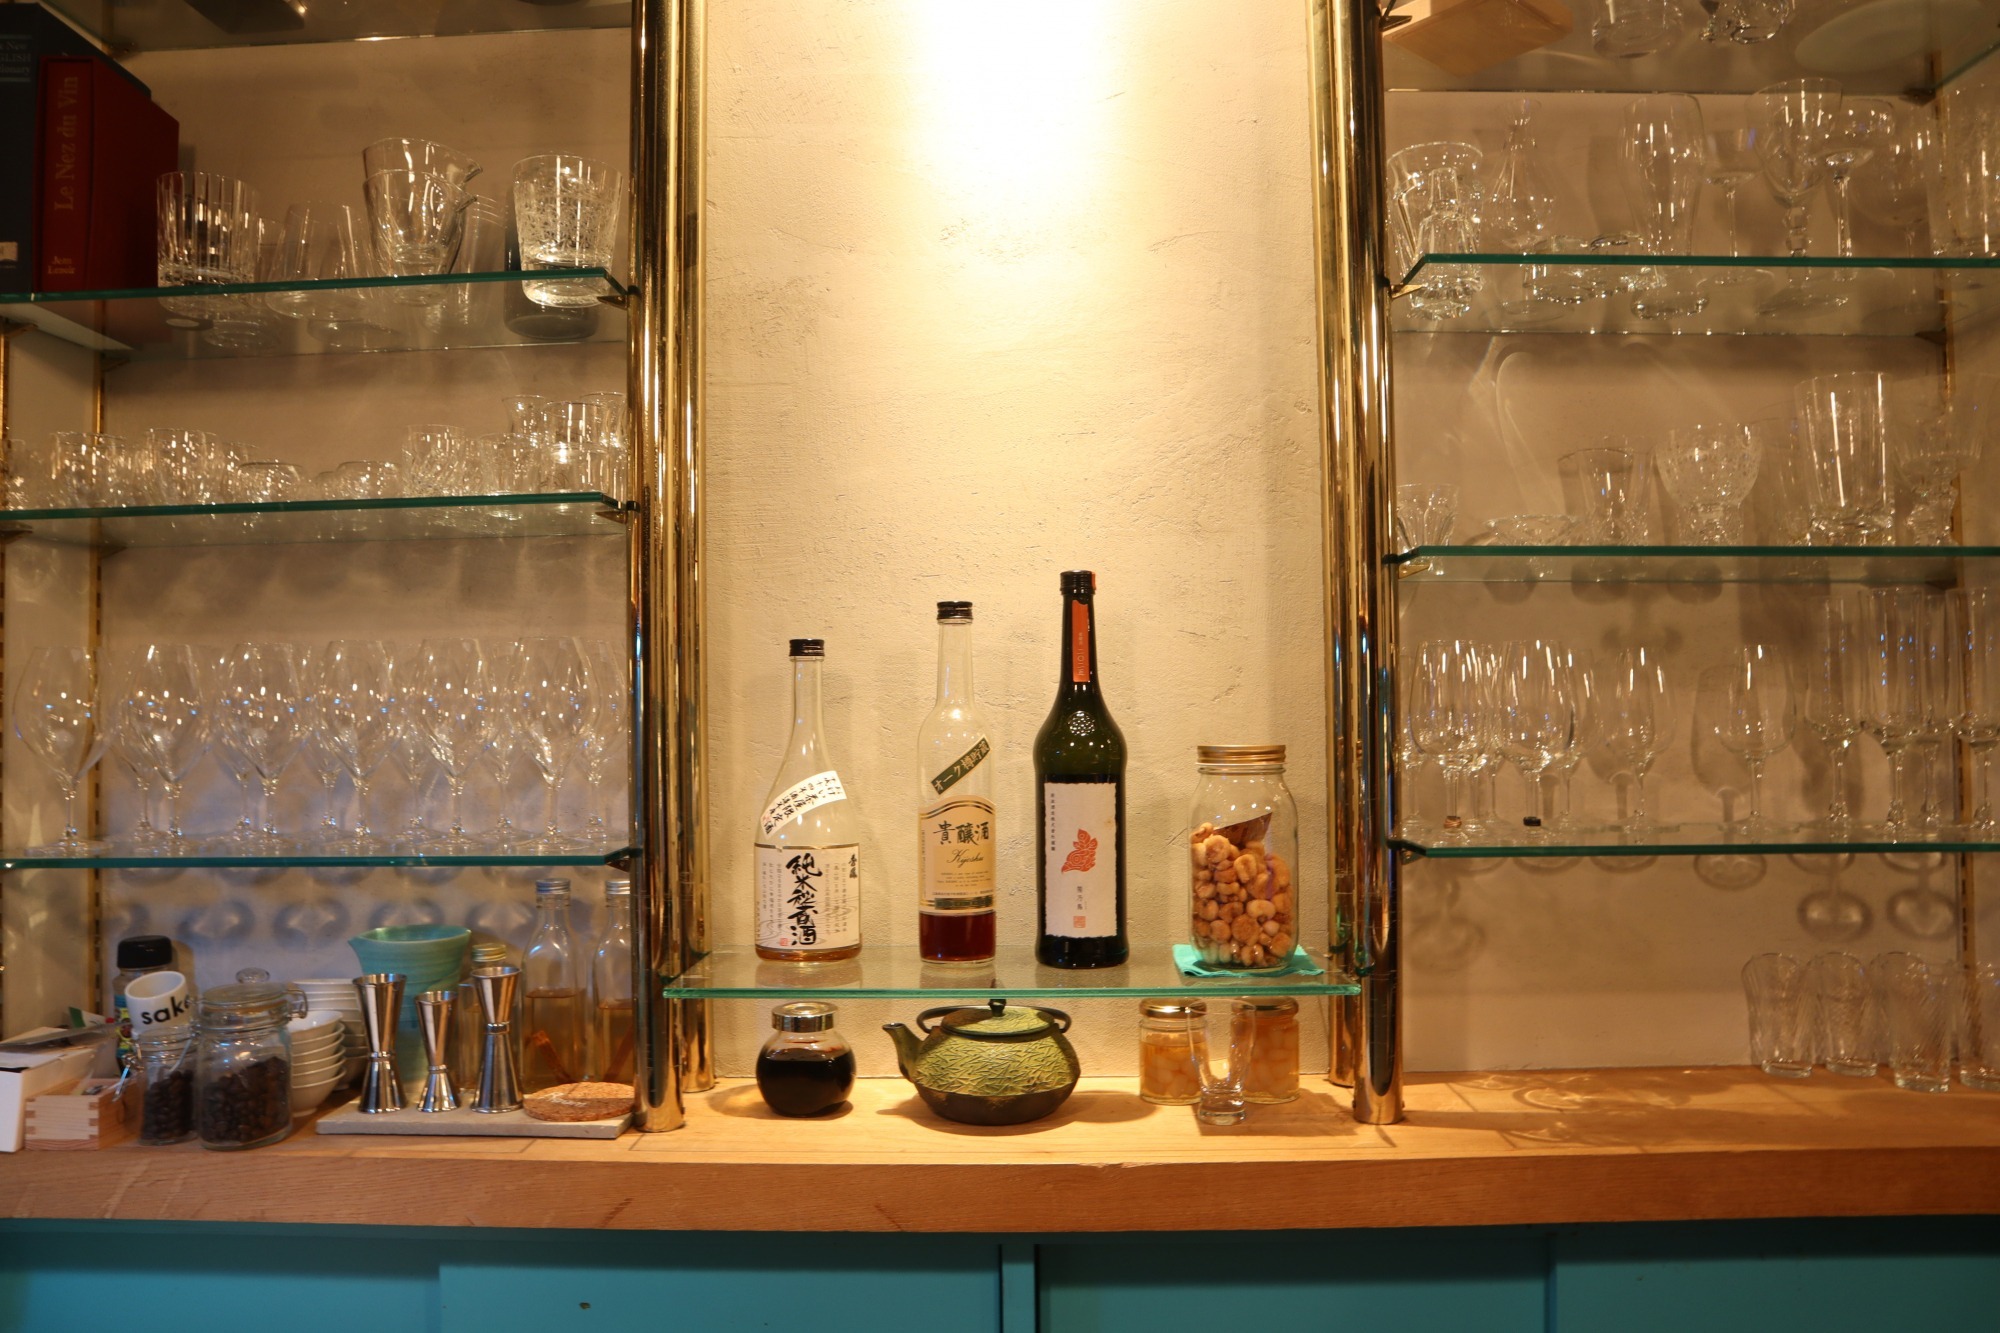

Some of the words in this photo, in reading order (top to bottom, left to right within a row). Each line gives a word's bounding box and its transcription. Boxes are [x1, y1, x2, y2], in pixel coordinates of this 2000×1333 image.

[59, 76, 78, 109] Vin
[58, 114, 77, 138] du
[55, 143, 76, 181] Nez
[54, 186, 74, 211] Le
[934, 740, 990, 792] オーク樽貯蔵
